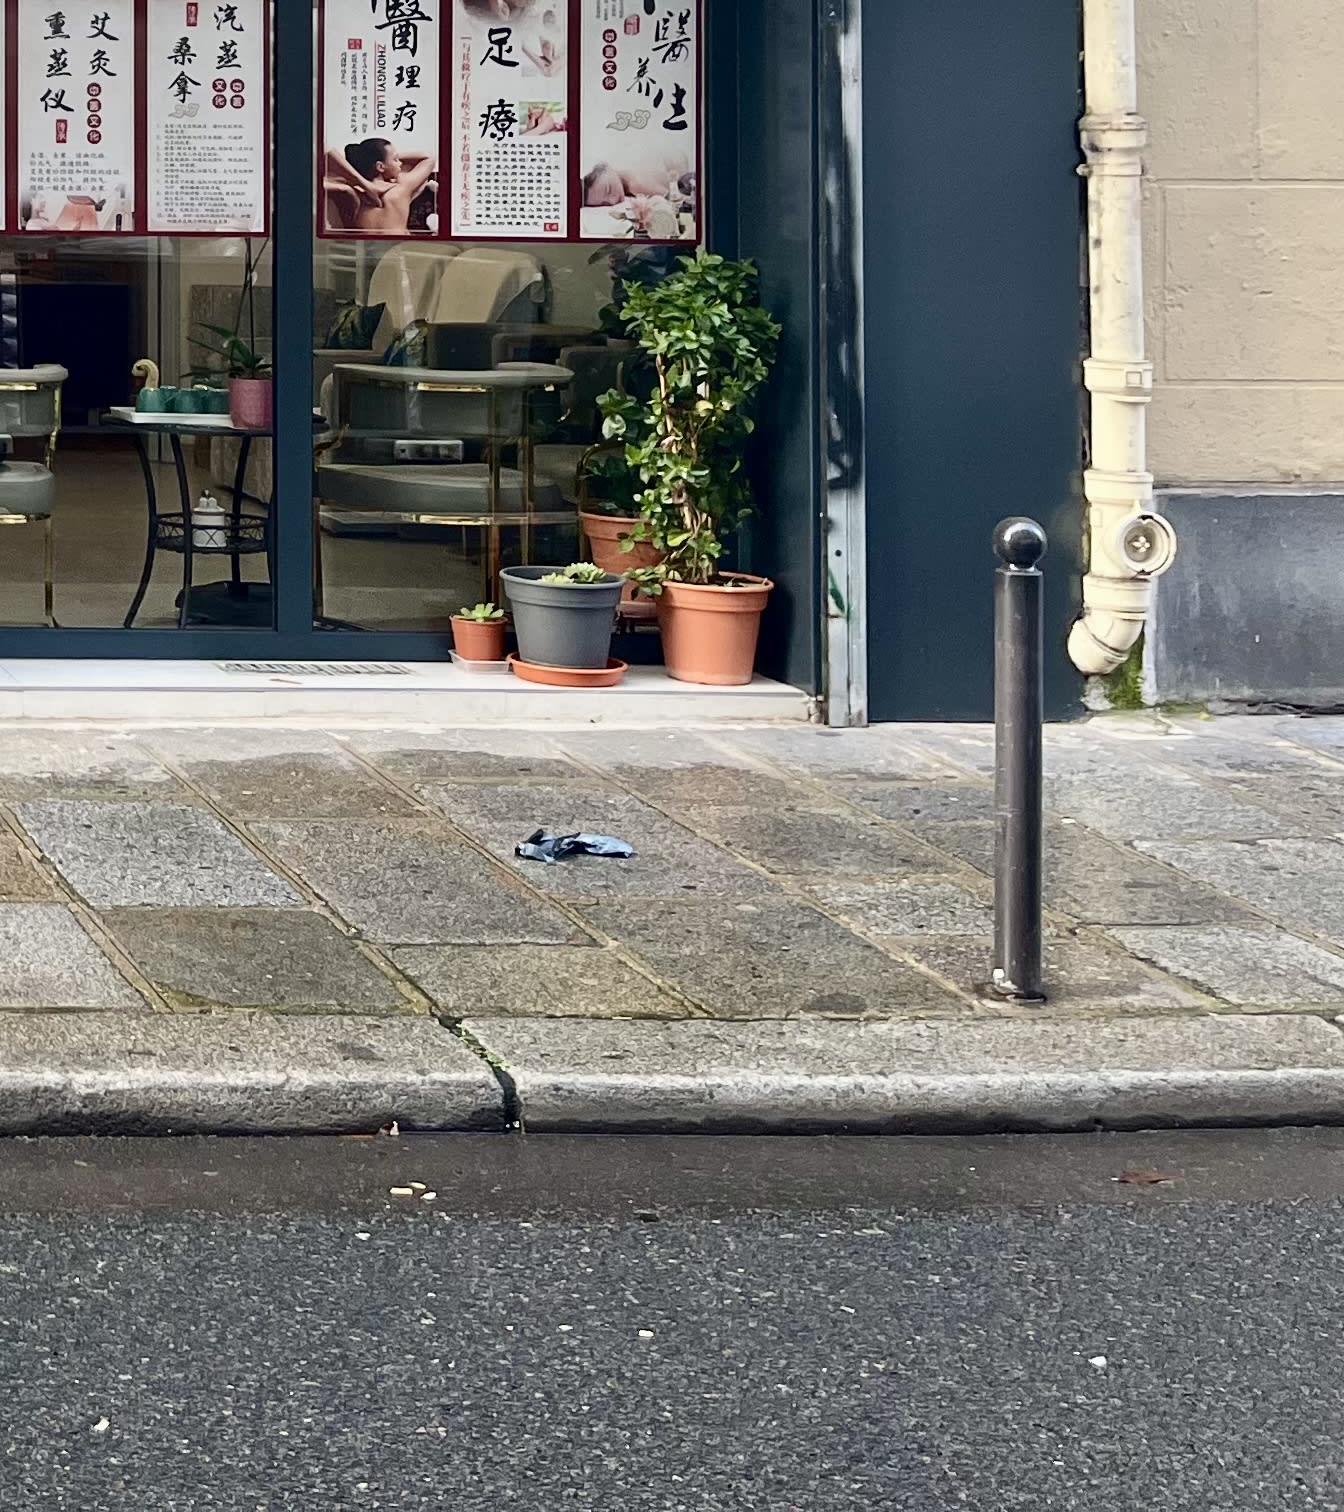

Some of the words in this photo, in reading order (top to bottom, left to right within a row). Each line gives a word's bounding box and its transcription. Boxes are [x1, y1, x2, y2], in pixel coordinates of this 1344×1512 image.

[85, 12, 119, 77] 艾灸
[167, 36, 202, 104] 桑拿
[376, 44, 387, 92] ZHONGYI
